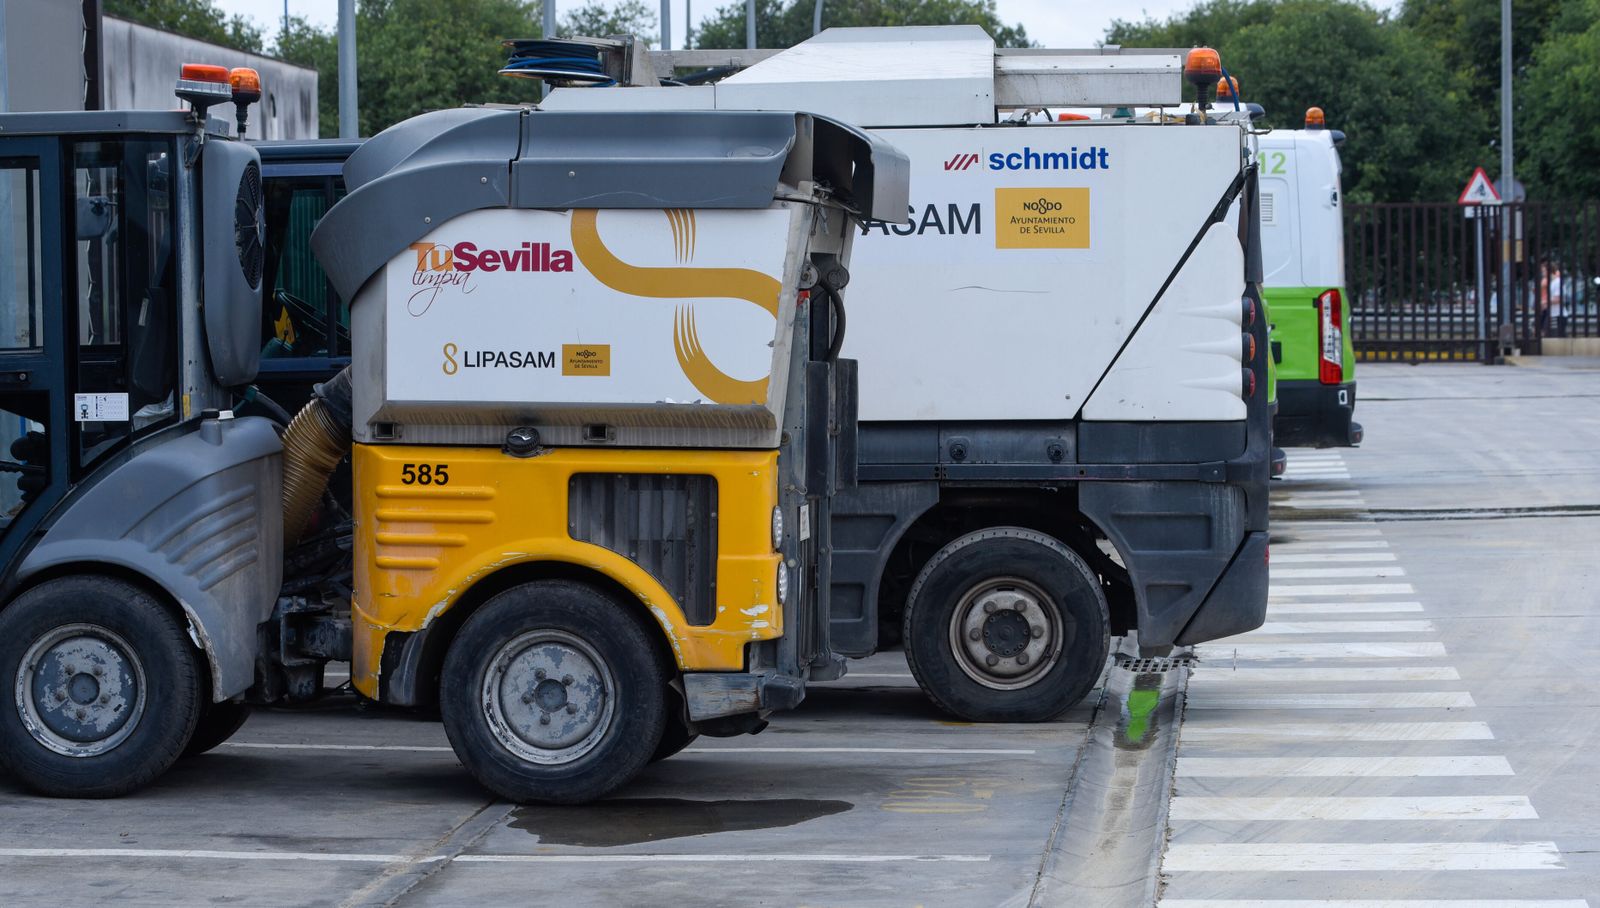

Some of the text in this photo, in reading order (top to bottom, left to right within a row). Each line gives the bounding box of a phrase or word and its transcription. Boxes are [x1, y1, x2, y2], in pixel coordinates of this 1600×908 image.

[989, 146, 1109, 171] schmidt
[1010, 216, 1076, 224] AYUNTAMIENTO
[1020, 225, 1065, 234] DE SEVILLA
[464, 350, 555, 369] LIPASAM
[401, 463, 449, 486] 585
